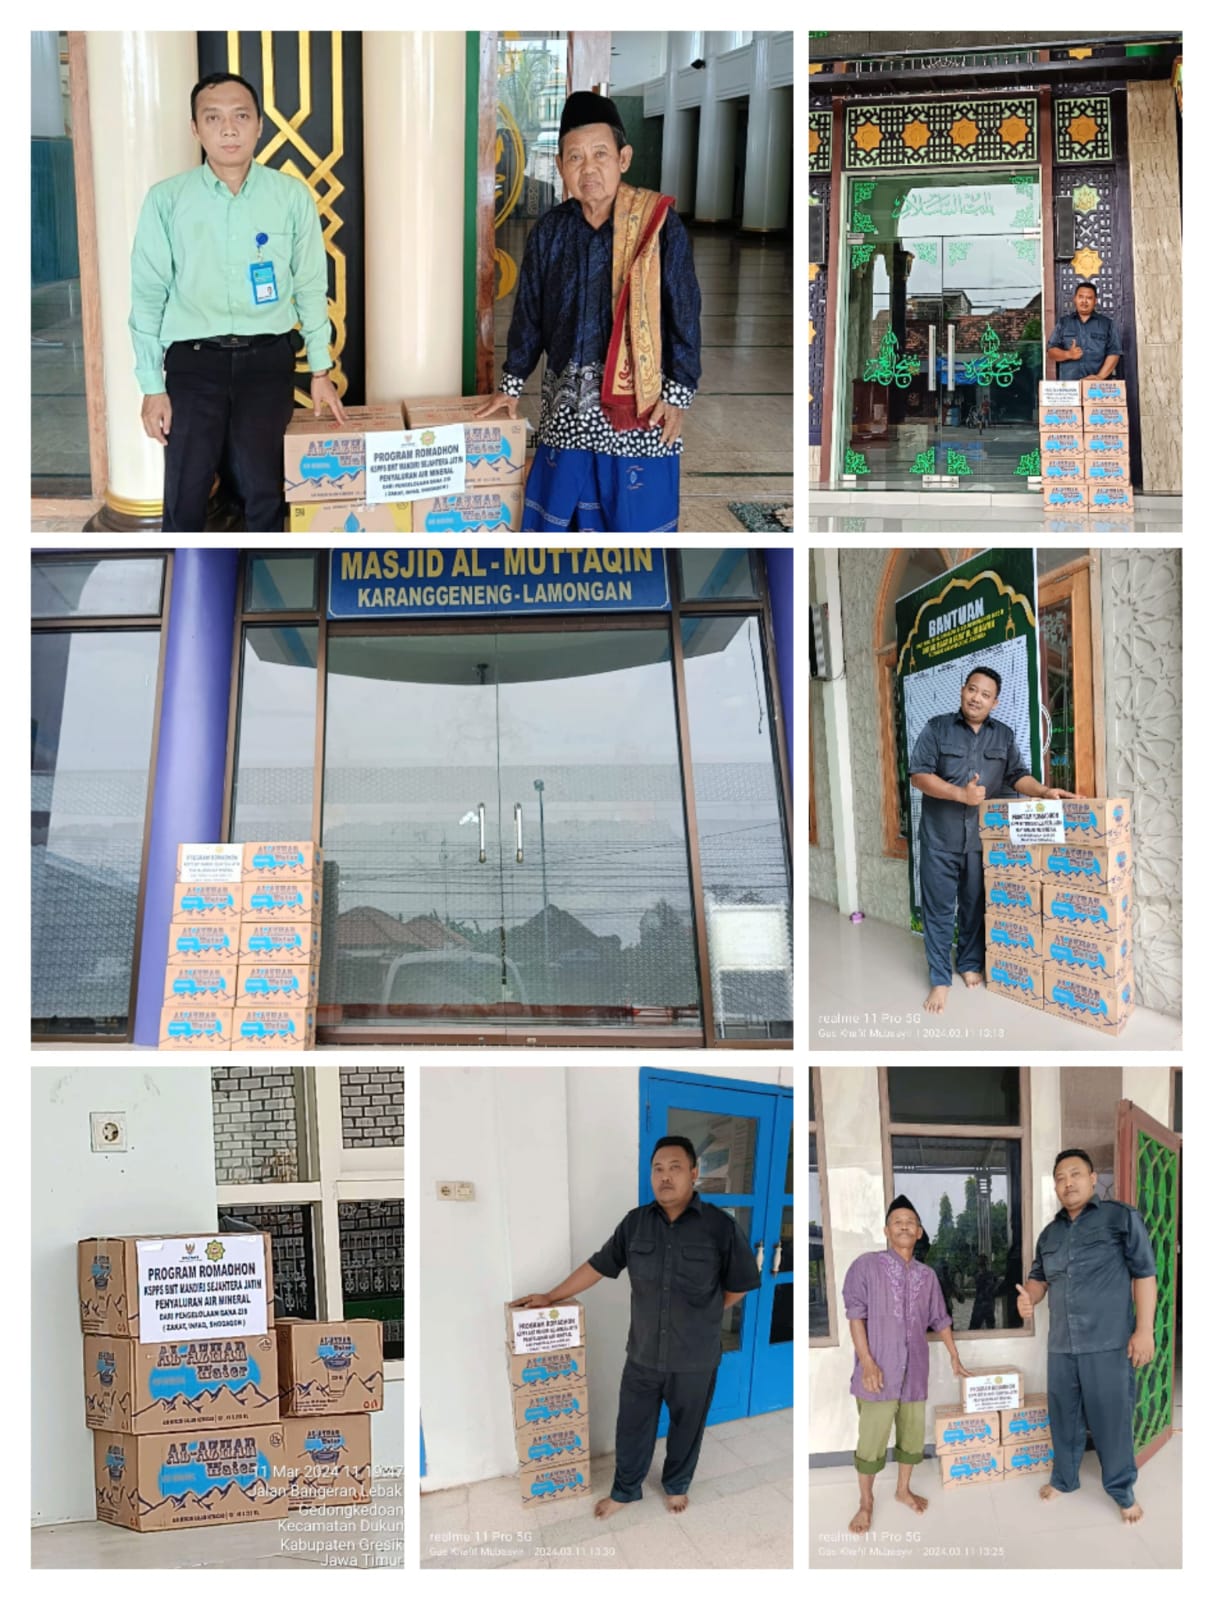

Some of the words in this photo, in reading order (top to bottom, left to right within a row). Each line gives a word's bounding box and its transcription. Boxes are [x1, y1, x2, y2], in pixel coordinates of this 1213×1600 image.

[374, 450, 413, 462] PROGRAM
[415, 444, 459, 458] ROMADHON
[418, 470, 428, 478] AIR
[430, 467, 454, 476] MINERAL
[341, 550, 444, 580] MASJID
[928, 597, 984, 638] BANTUAN
[148, 1265, 196, 1281] PROGRAM
[199, 1262, 256, 1278] ROMADHON
[144, 1285, 164, 1296] KSPPS
[165, 1284, 178, 1294] BMT
[180, 1282, 205, 1293] MANDIRI
[207, 1280, 242, 1292] SEJAHTERA
[244, 1279, 262, 1289] JATIM
[155, 1297, 203, 1310] PENYALURAN
[204, 1296, 217, 1306] AIR
[218, 1294, 251, 1304] MINERAL
[175, 1311, 219, 1319] PENGELOLAAN
[157, 1341, 248, 1367] AL-AZHAR
[197, 1364, 248, 1379] Water
[166, 1437, 257, 1464] AL-AZHAR
[206, 1461, 257, 1477] Water
